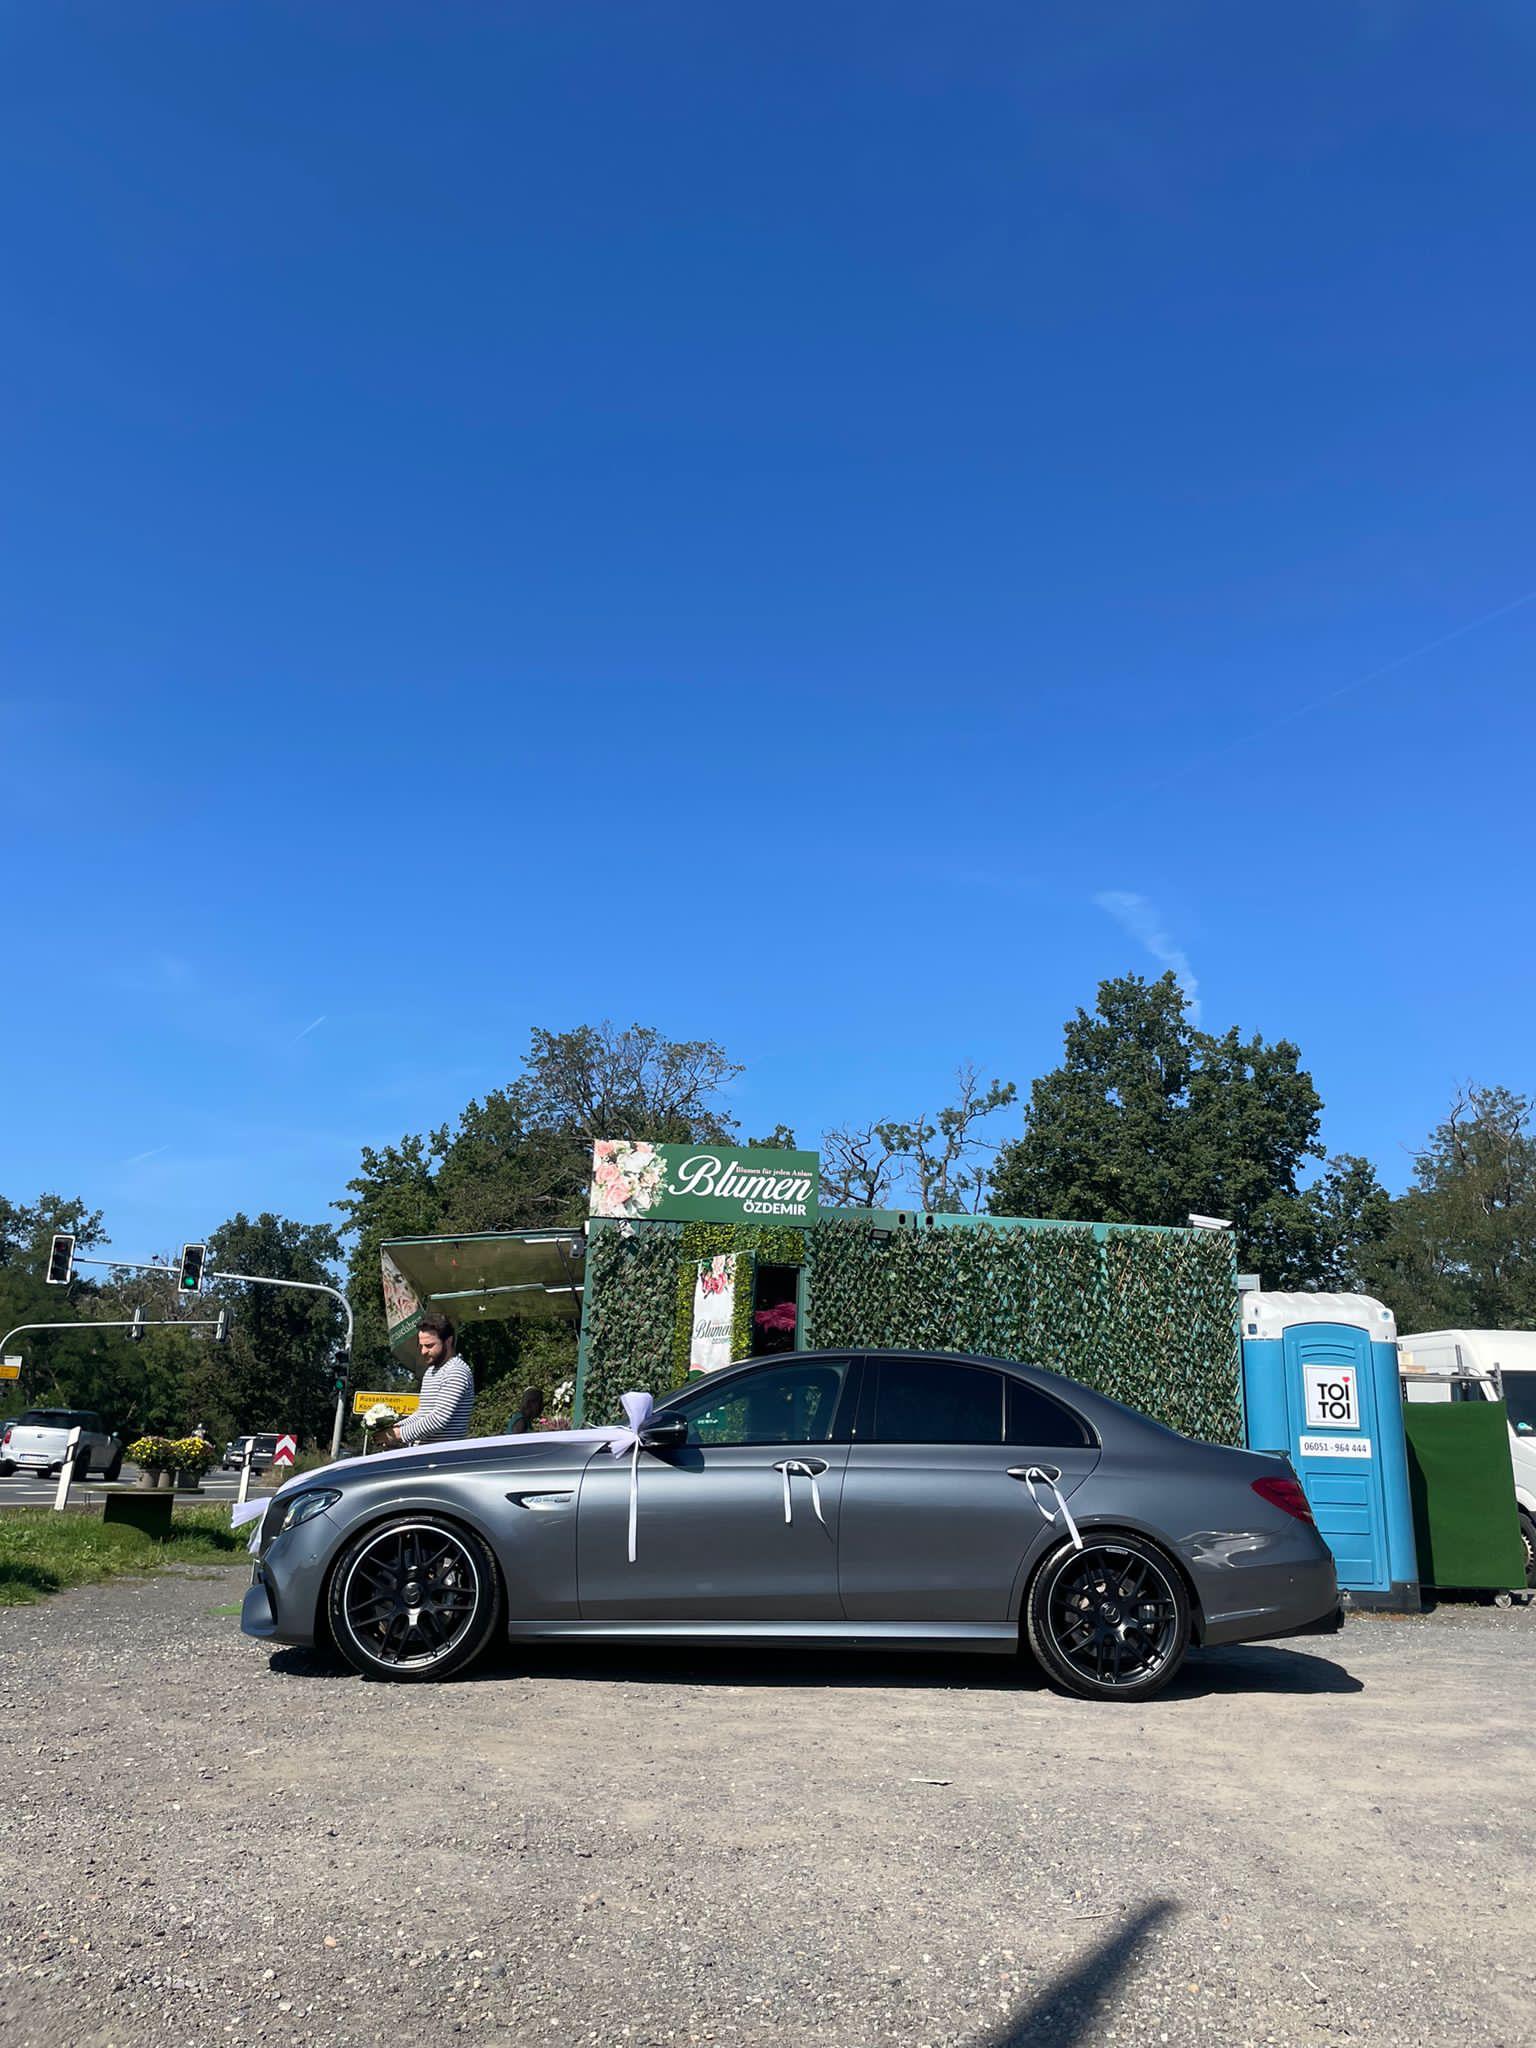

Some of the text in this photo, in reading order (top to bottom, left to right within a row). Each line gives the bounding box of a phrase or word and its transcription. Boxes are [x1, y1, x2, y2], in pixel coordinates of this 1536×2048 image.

[668, 1155, 814, 1201] Blumen
[743, 1200, 807, 1216] ÖZDEMIR
[695, 1319, 733, 1339] Blumen
[1316, 1383, 1350, 1401] TOI
[1318, 1401, 1351, 1420] TOI
[1303, 1442, 1328, 1452] 06051
[1334, 1443, 1350, 1452] 964
[1352, 1443, 1367, 1453] 444
